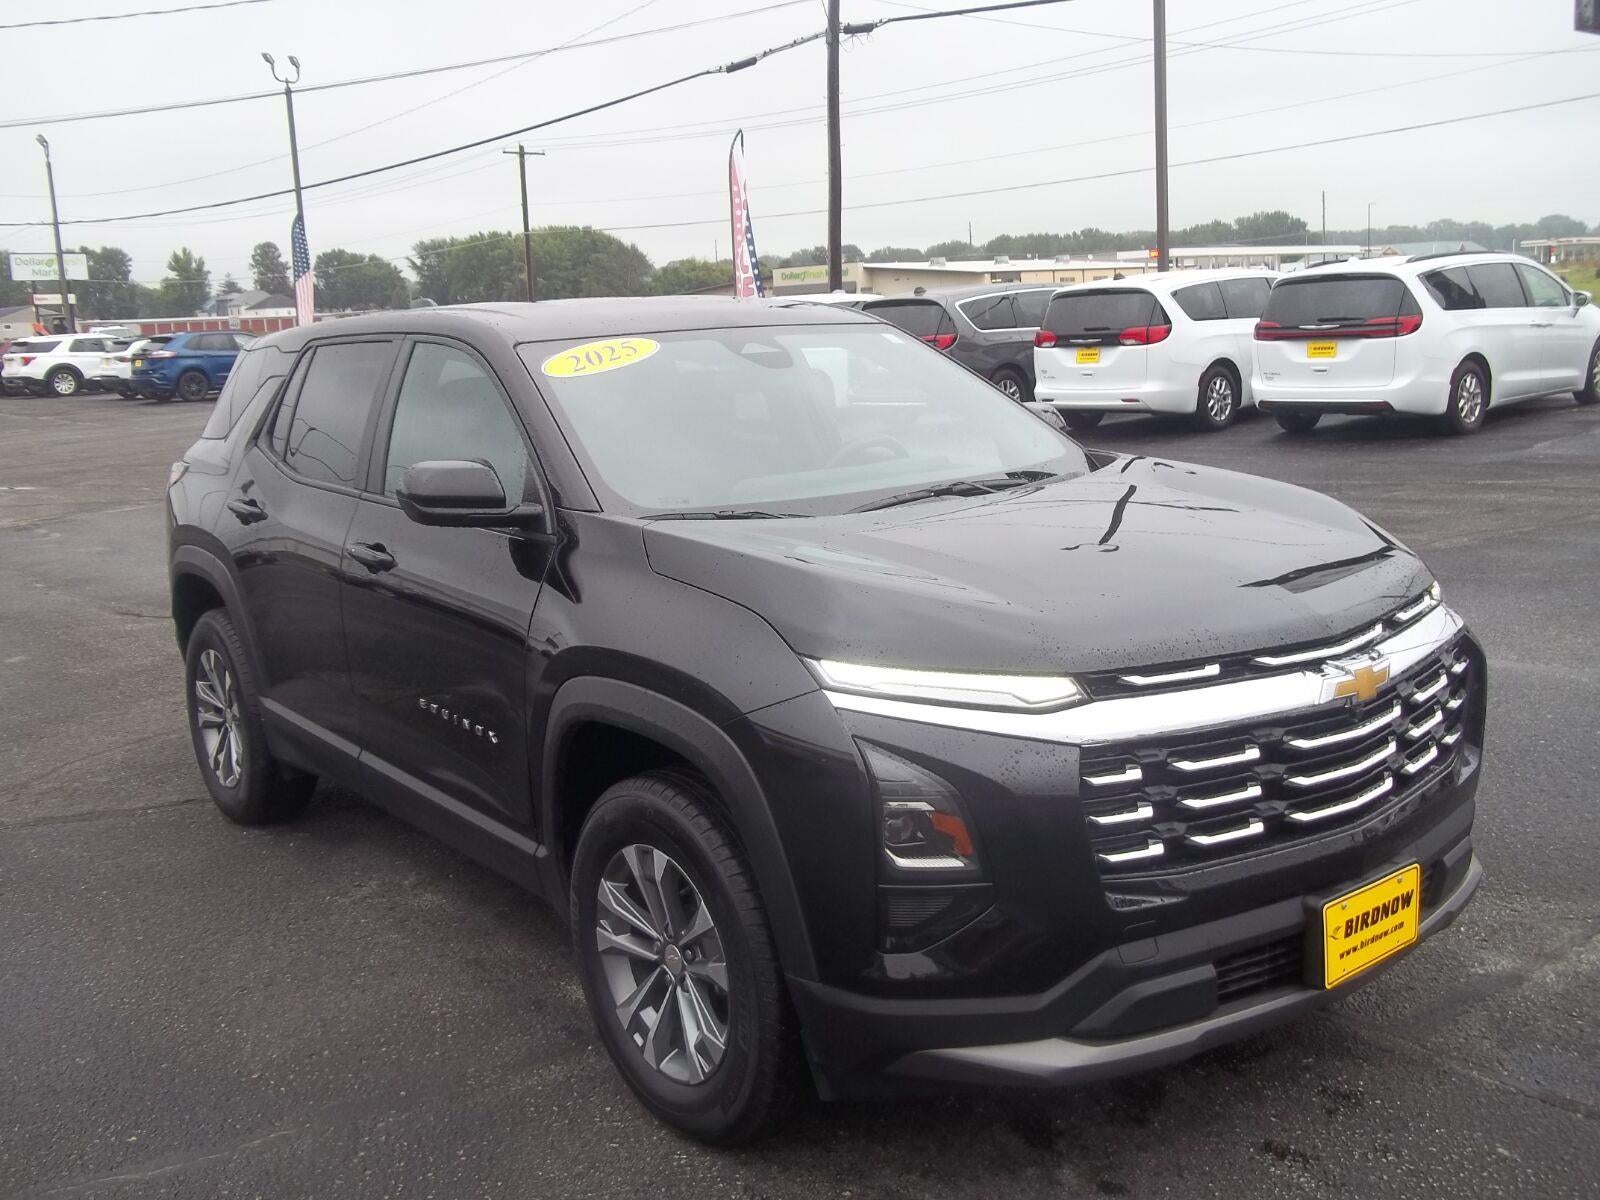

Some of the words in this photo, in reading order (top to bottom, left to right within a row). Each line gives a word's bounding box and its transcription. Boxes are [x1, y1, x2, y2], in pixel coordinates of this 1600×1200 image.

[566, 341, 638, 372] 2025
[419, 698, 498, 744] EQUINOX
[1344, 889, 1414, 939] BIRDNOW
[1338, 920, 1405, 960] www.birdnow.com
